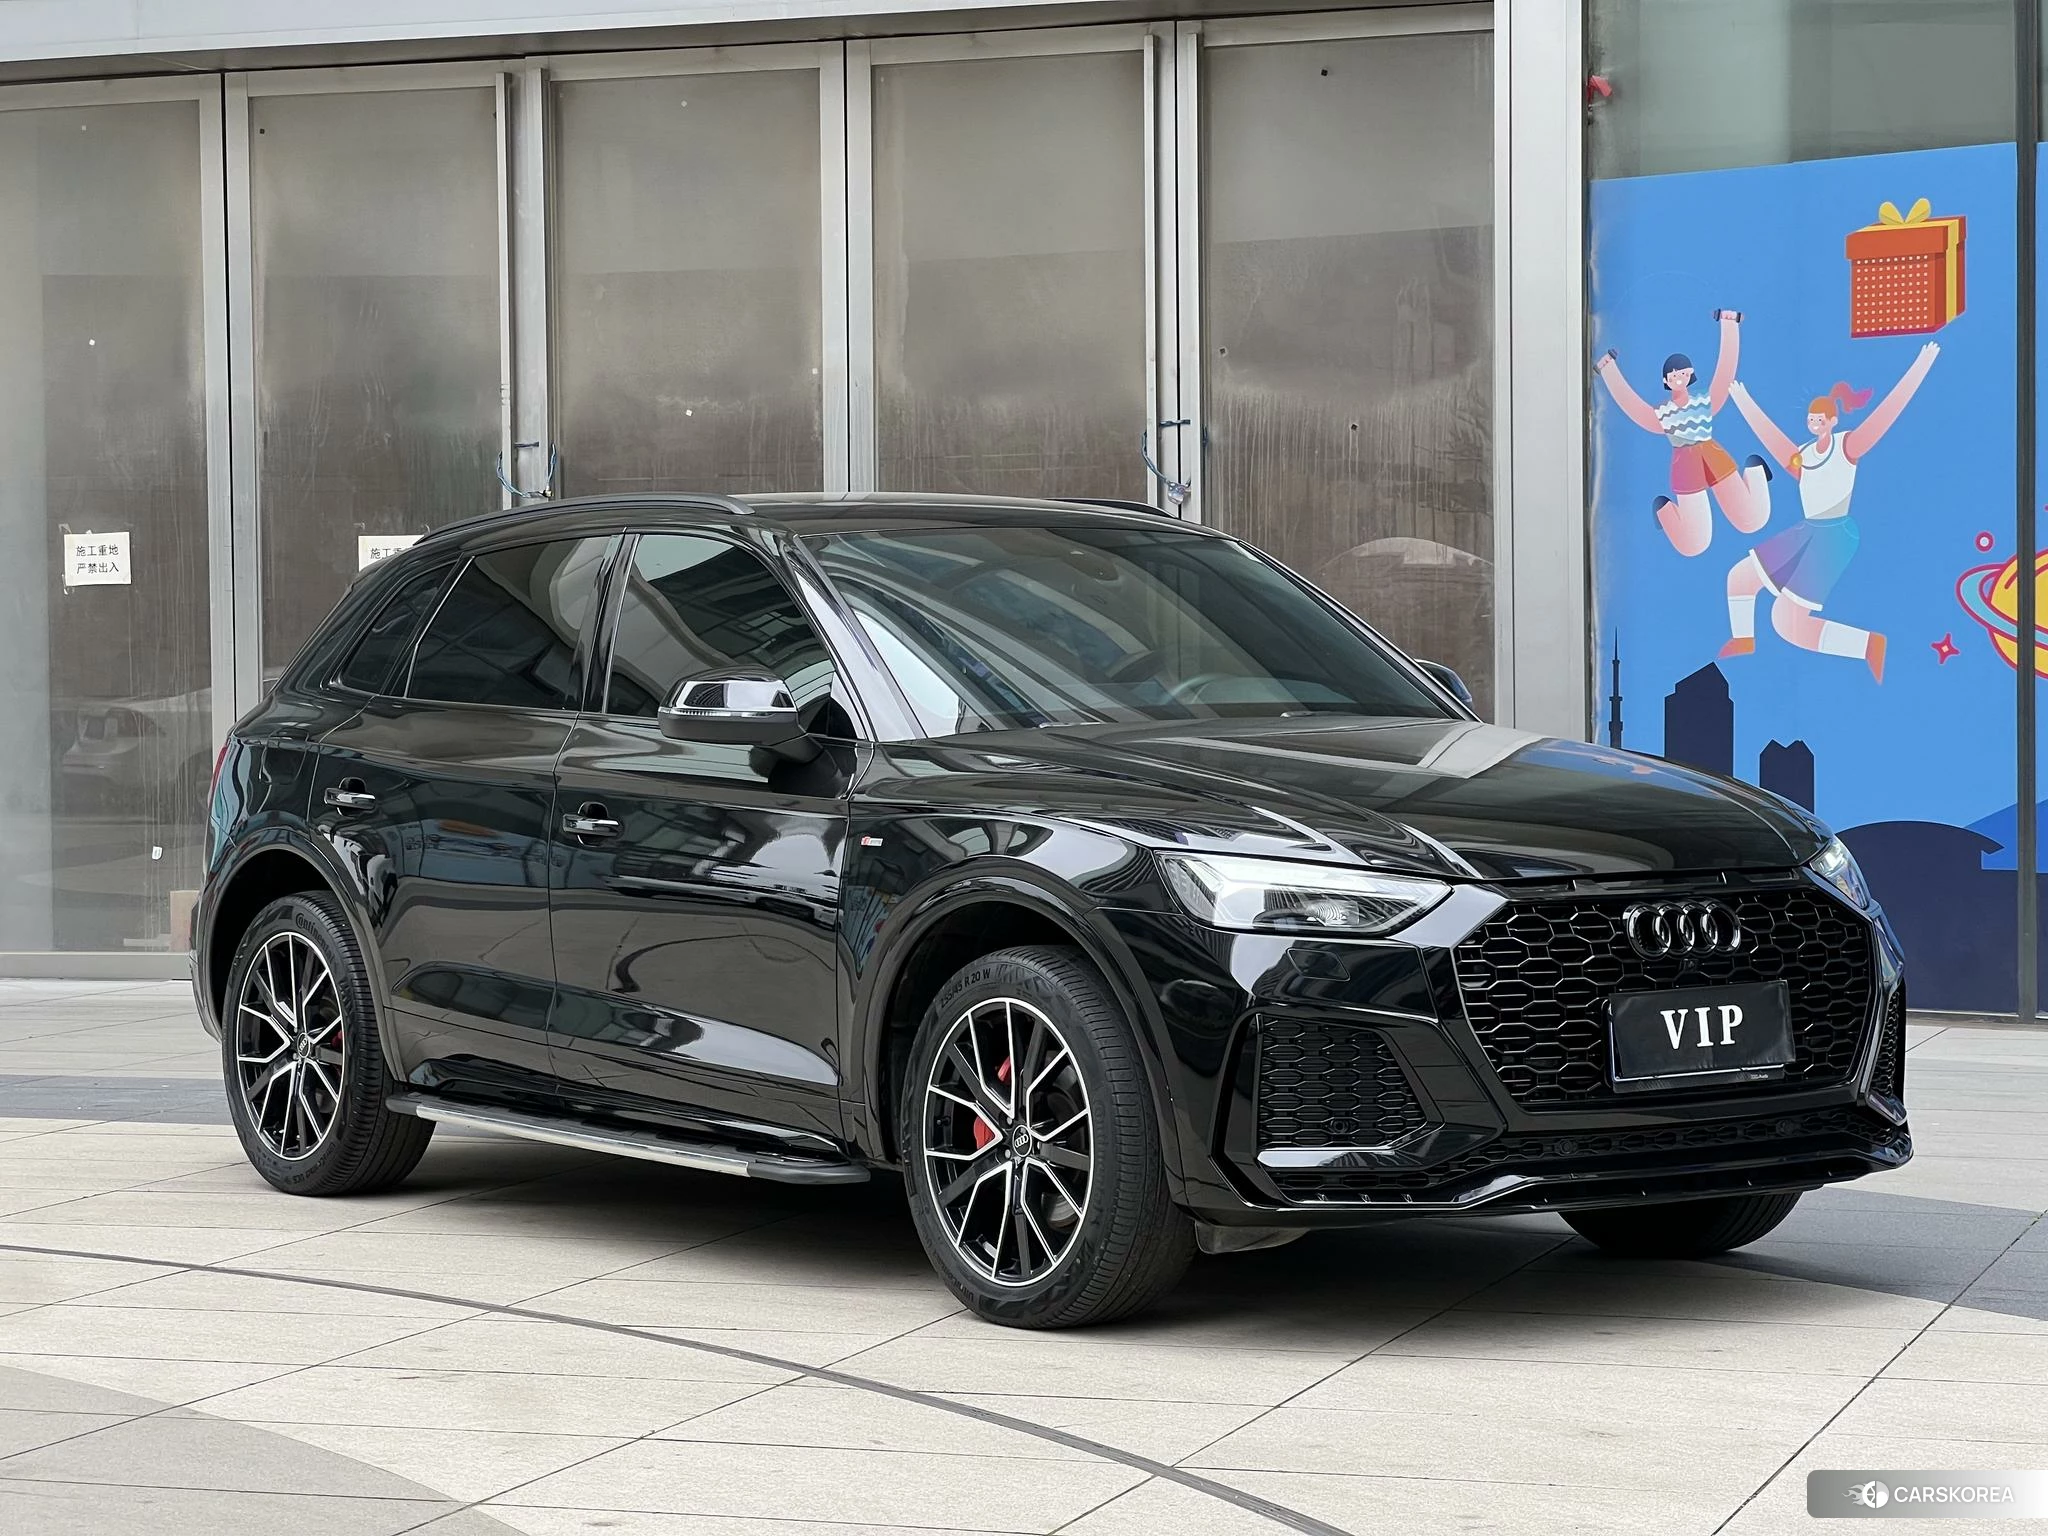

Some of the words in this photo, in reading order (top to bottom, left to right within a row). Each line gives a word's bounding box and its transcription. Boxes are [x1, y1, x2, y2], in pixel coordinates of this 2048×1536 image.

[76, 544, 119, 556] 施工重地
[76, 562, 119, 574] 严禁出入
[971, 970, 981, 984] 20
[982, 967, 991, 980] W
[1660, 1004, 1743, 1050] VIP
